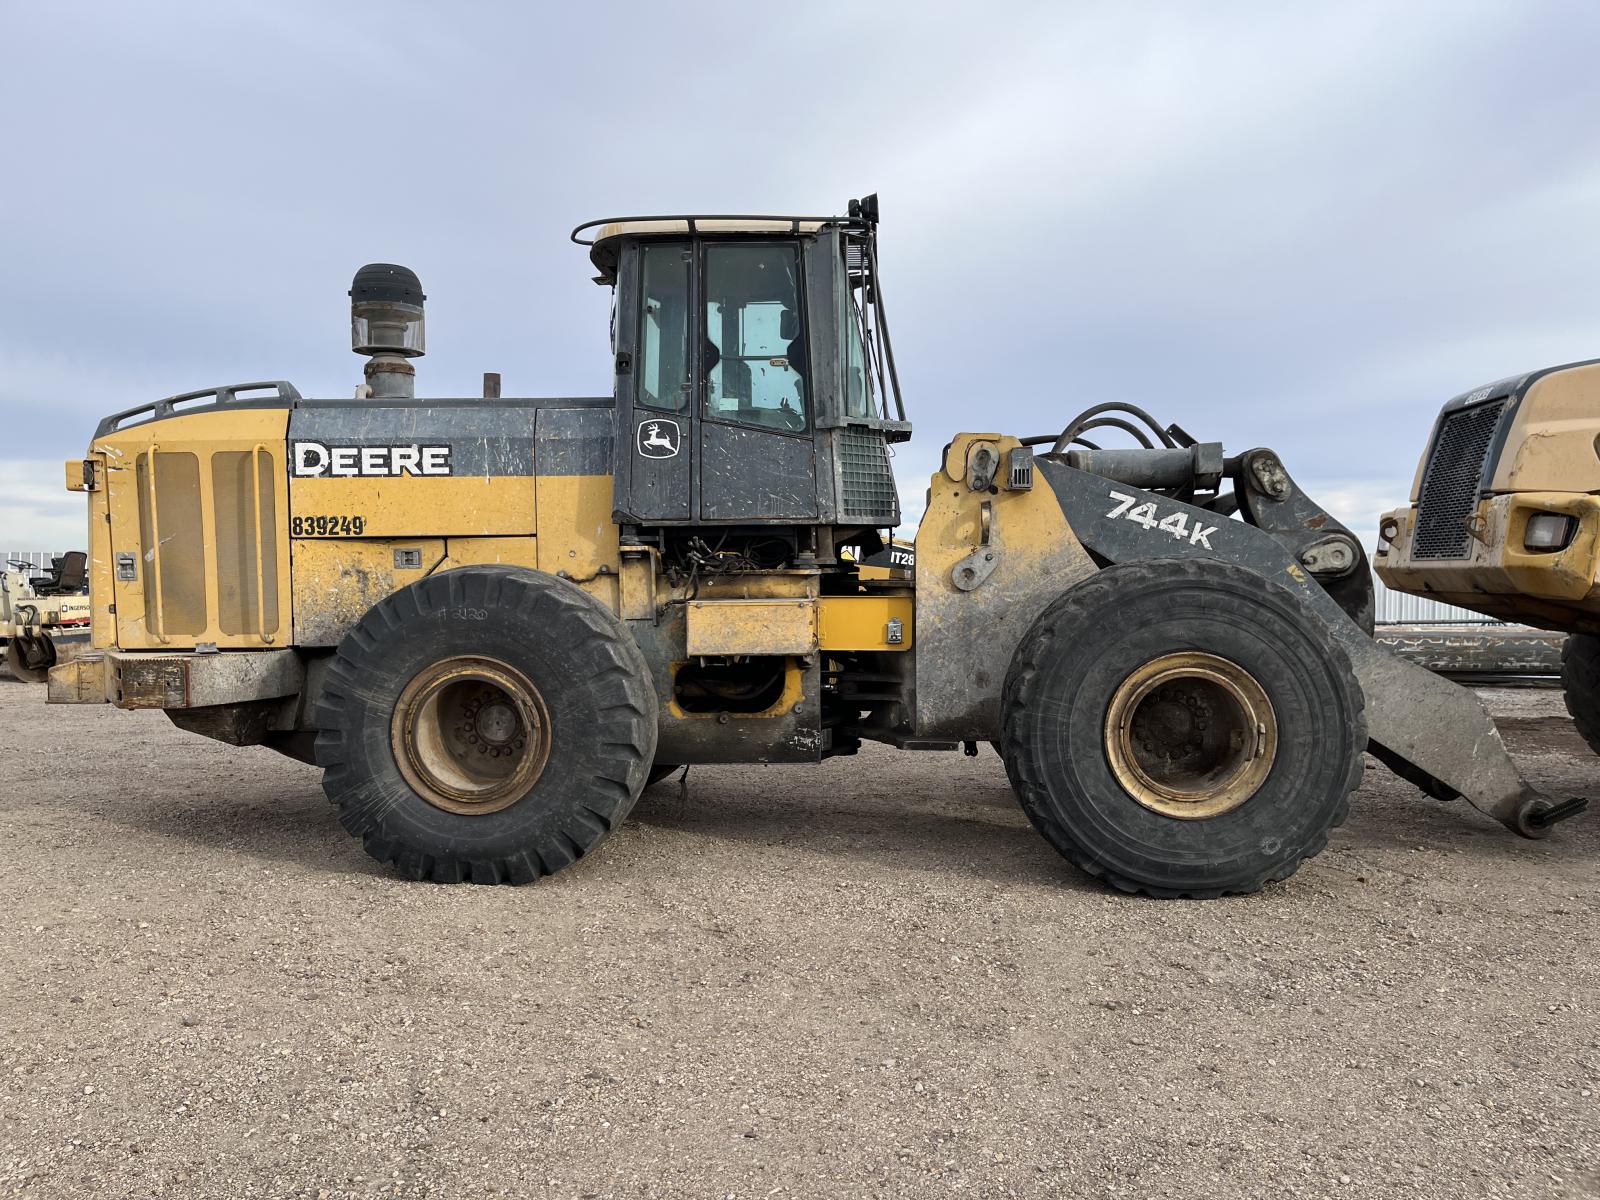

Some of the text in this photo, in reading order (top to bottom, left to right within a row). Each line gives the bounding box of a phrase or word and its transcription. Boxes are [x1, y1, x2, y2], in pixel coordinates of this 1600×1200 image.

[295, 442, 450, 475] DEERE
[292, 516, 364, 536] 839249
[1106, 490, 1219, 550] 744K
